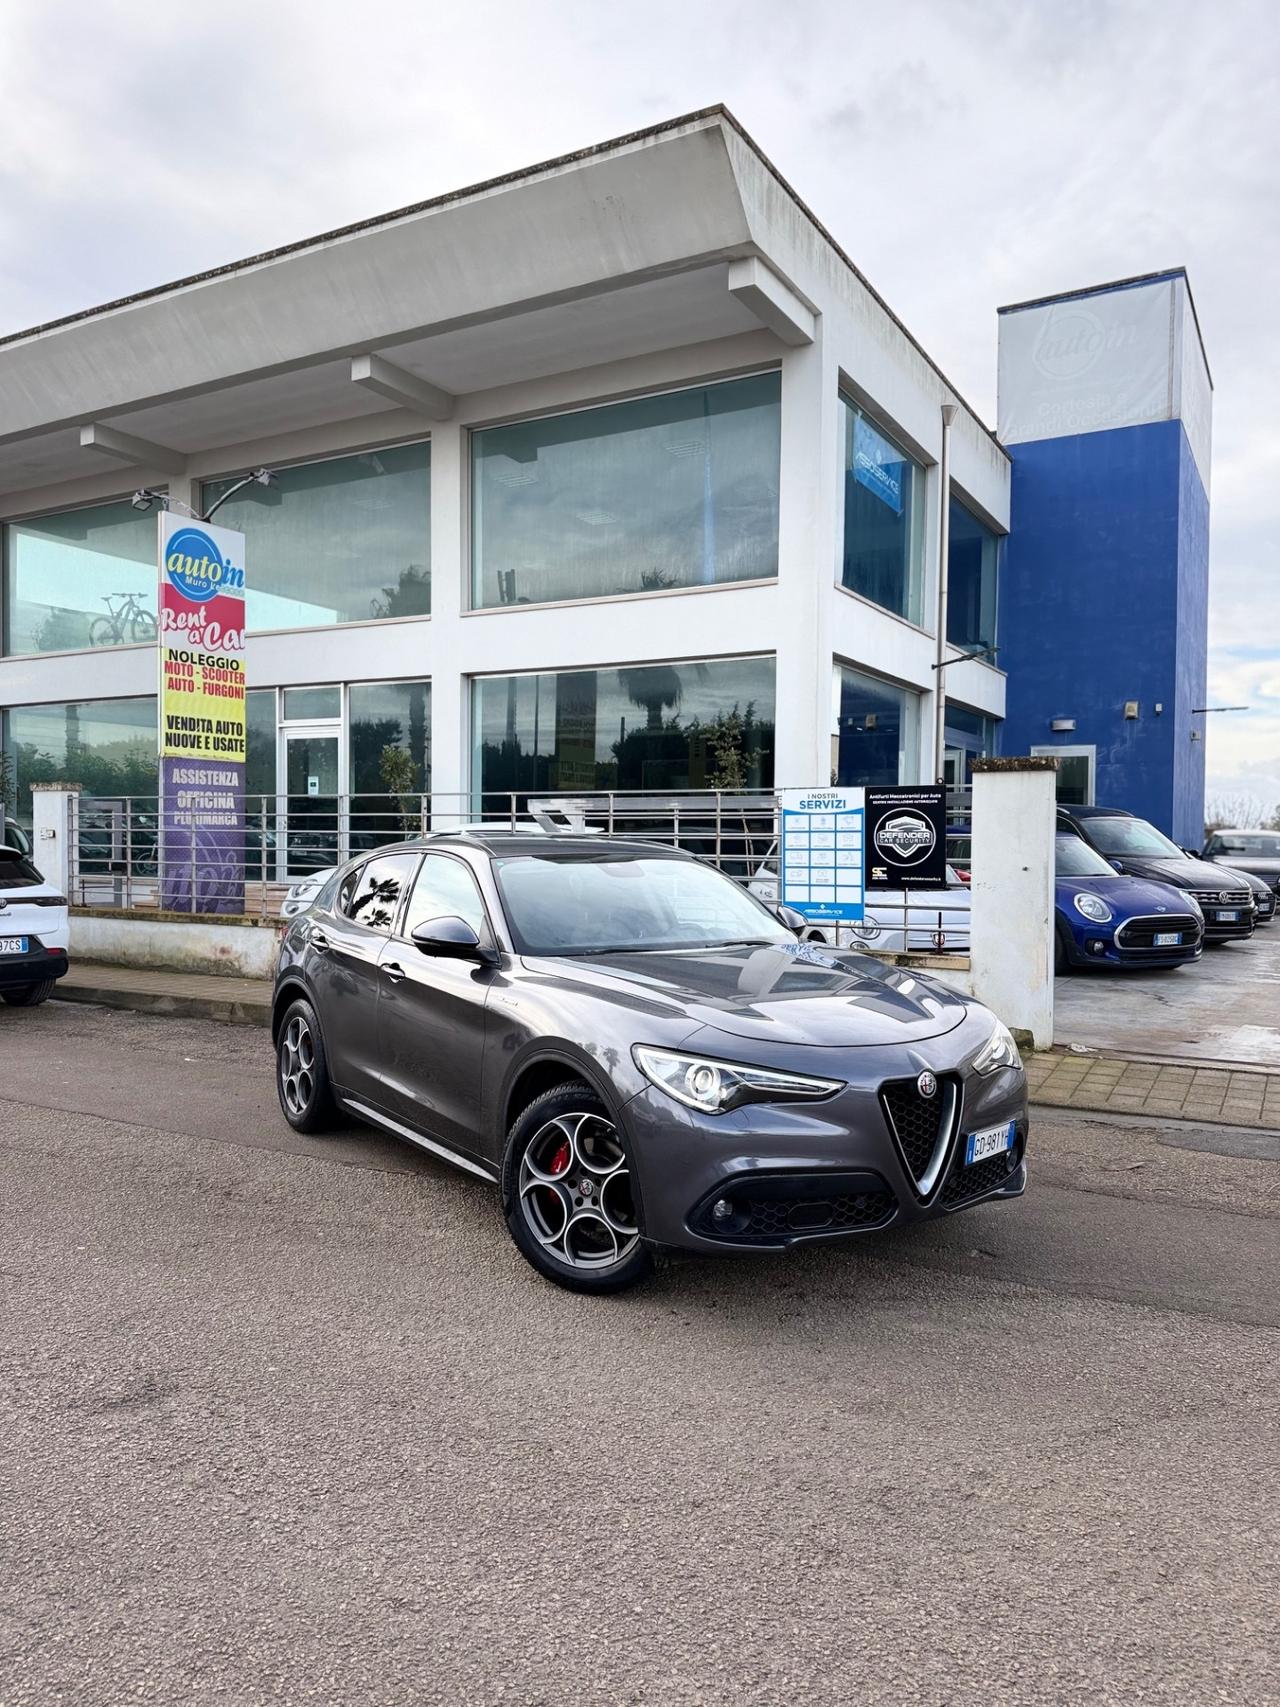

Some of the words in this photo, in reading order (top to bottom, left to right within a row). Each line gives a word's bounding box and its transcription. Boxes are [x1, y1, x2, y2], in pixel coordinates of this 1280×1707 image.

[162, 606, 207, 630] Rent
[169, 649, 240, 671] NOLEGGIO
[165, 661, 193, 677] MOTO
[202, 666, 245, 685] SCOOTER
[168, 677, 194, 693] AUTO
[203, 682, 244, 699] FURGONI
[166, 715, 213, 734] VENDITA
[216, 720, 243, 736] AUTO
[165, 732, 202, 749] NUOVE
[205, 735, 211, 750] E
[213, 737, 245, 753] USATE
[172, 768, 239, 787] ASSISTENZA
[177, 790, 235, 809] OFFICINA
[800, 800, 846, 809] SERVIZI
